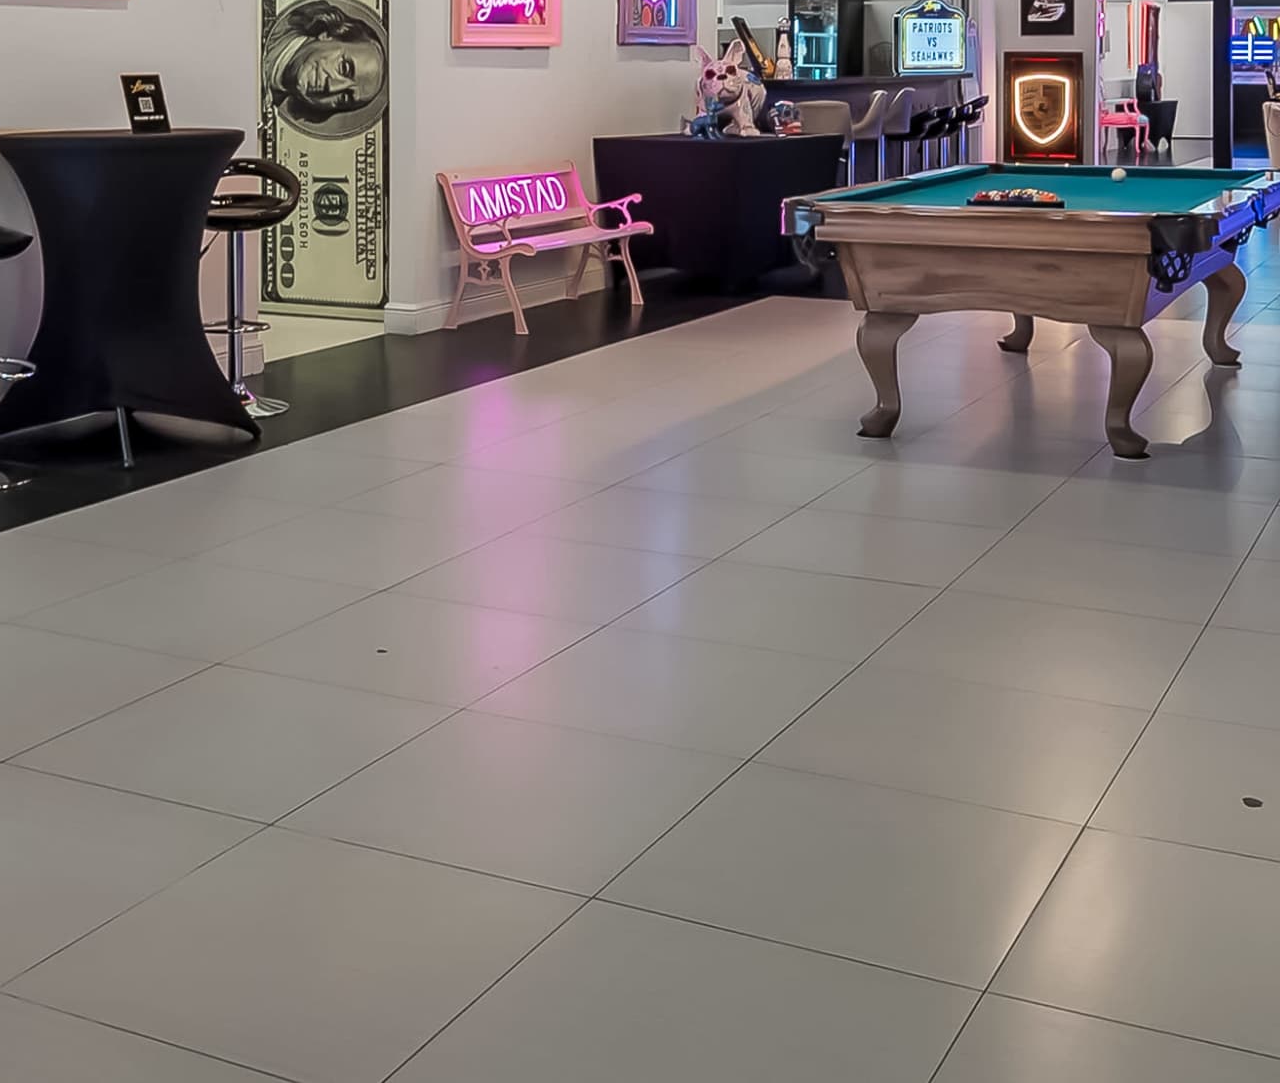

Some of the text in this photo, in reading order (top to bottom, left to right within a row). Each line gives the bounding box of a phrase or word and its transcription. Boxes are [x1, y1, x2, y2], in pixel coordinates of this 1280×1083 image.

[912, 22, 953, 34] PATRIOTS
[926, 36, 937, 48] VS
[911, 51, 954, 62] SEAHAWKS
[469, 176, 567, 223] AMISTAD
